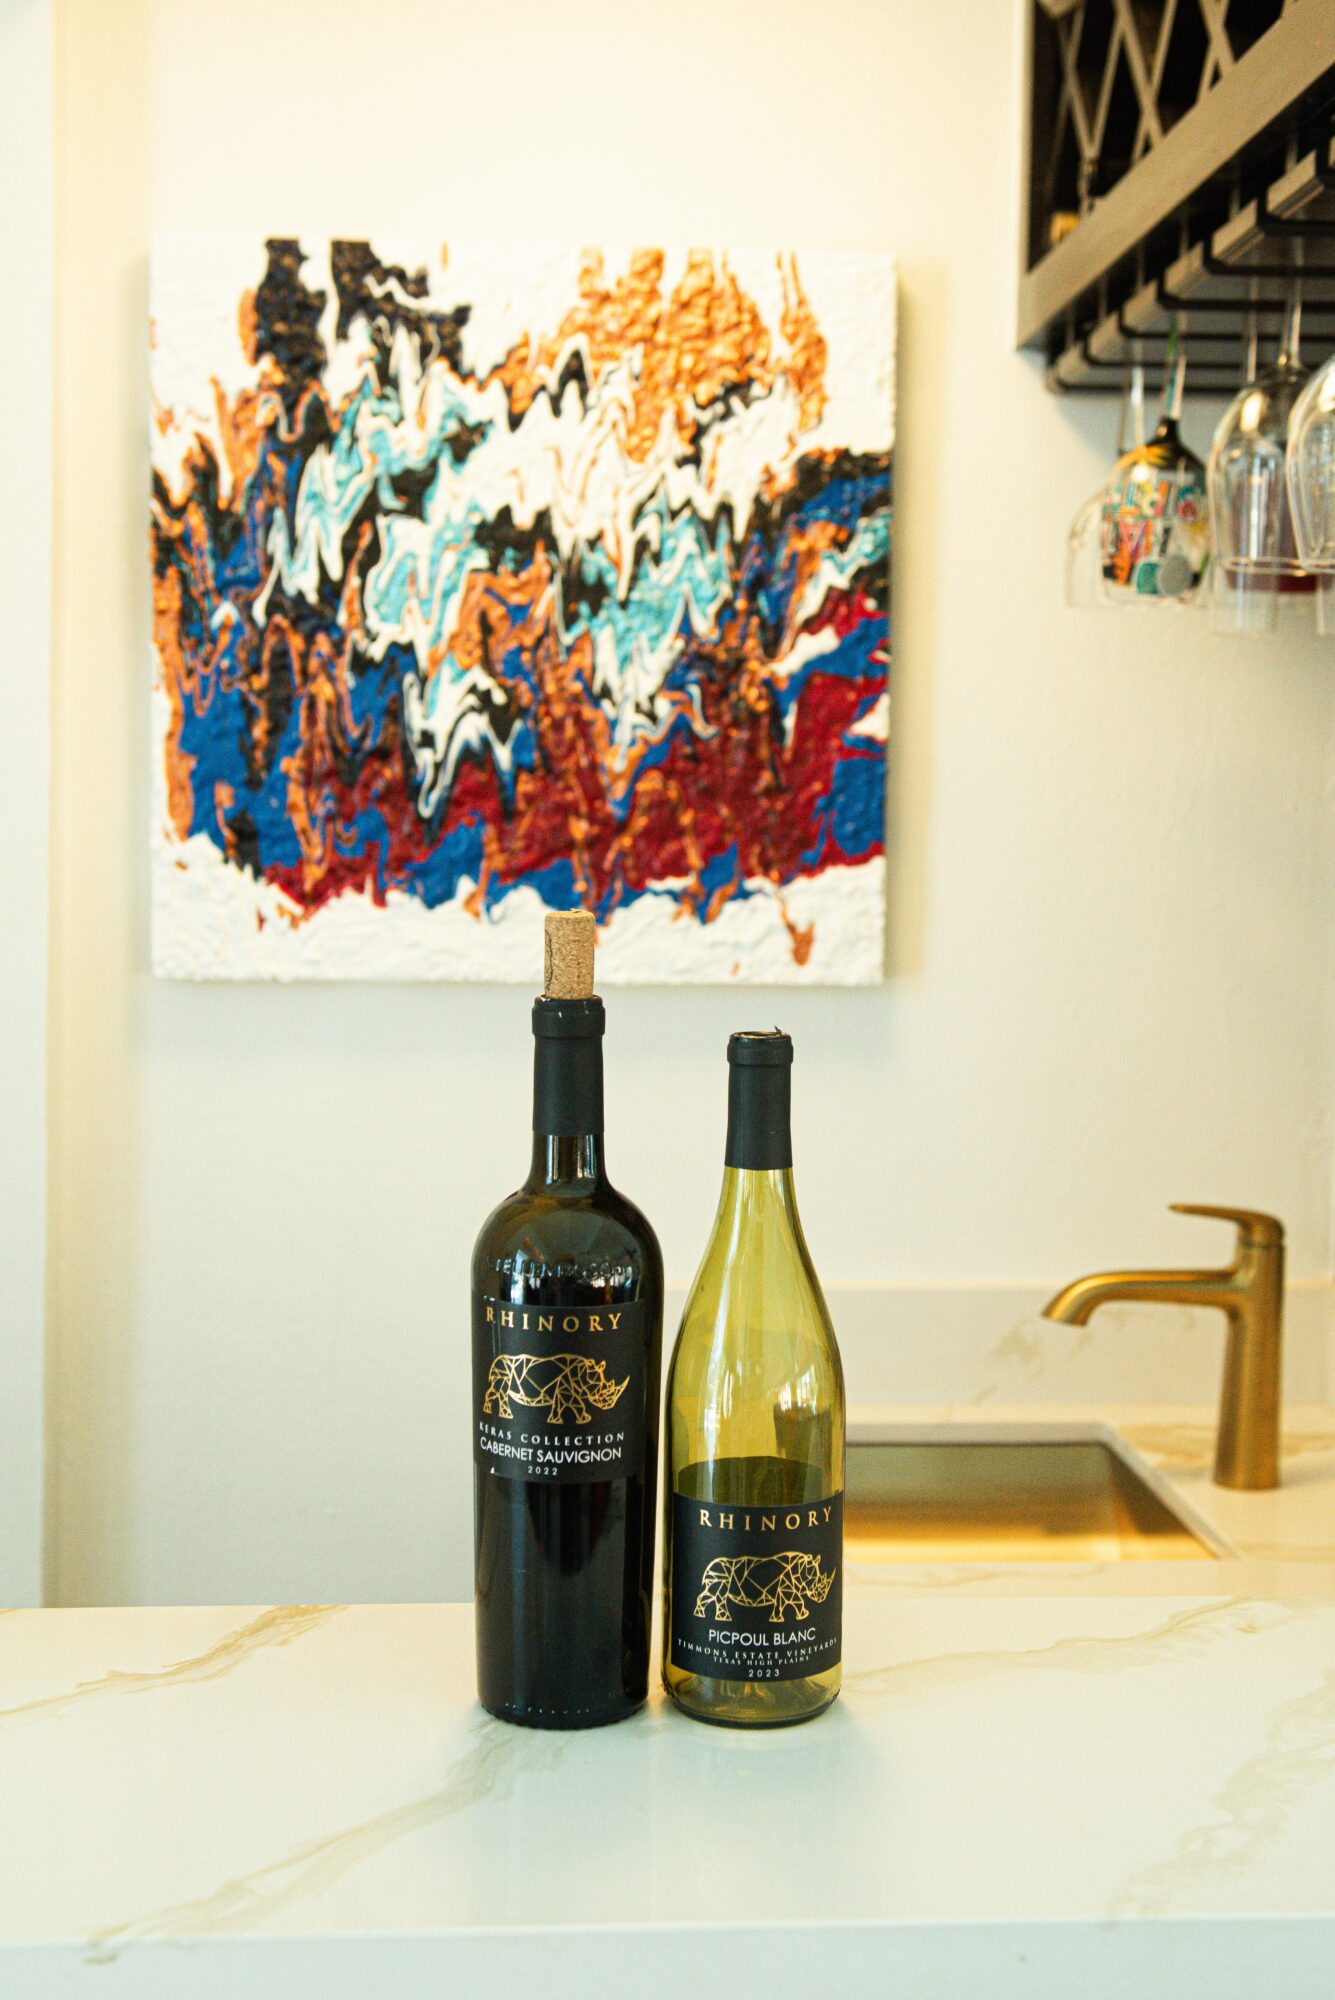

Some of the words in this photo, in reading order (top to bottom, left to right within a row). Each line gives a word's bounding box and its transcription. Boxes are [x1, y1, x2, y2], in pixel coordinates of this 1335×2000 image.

[486, 1306, 622, 1332] RHINORY
[479, 1421, 512, 1440] KERAS
[520, 1432, 624, 1446] COLLECTION
[480, 1436, 533, 1461] CABERNET
[536, 1447, 622, 1463] SAUVIGNON
[528, 1465, 558, 1476] 2022
[699, 1505, 832, 1532] RHINORY
[708, 1629, 769, 1646] PICPOUL
[773, 1627, 816, 1645] BLANC
[677, 1638, 727, 1658] TIMMONS
[735, 1651, 779, 1659] ESTATE
[786, 1637, 837, 1657] VINEYARDS
[713, 1656, 741, 1665] TEXAS
[747, 1657, 773, 1666] HIGH
[778, 1655, 809, 1665] PLAINS
[748, 1668, 780, 1677] 2023
